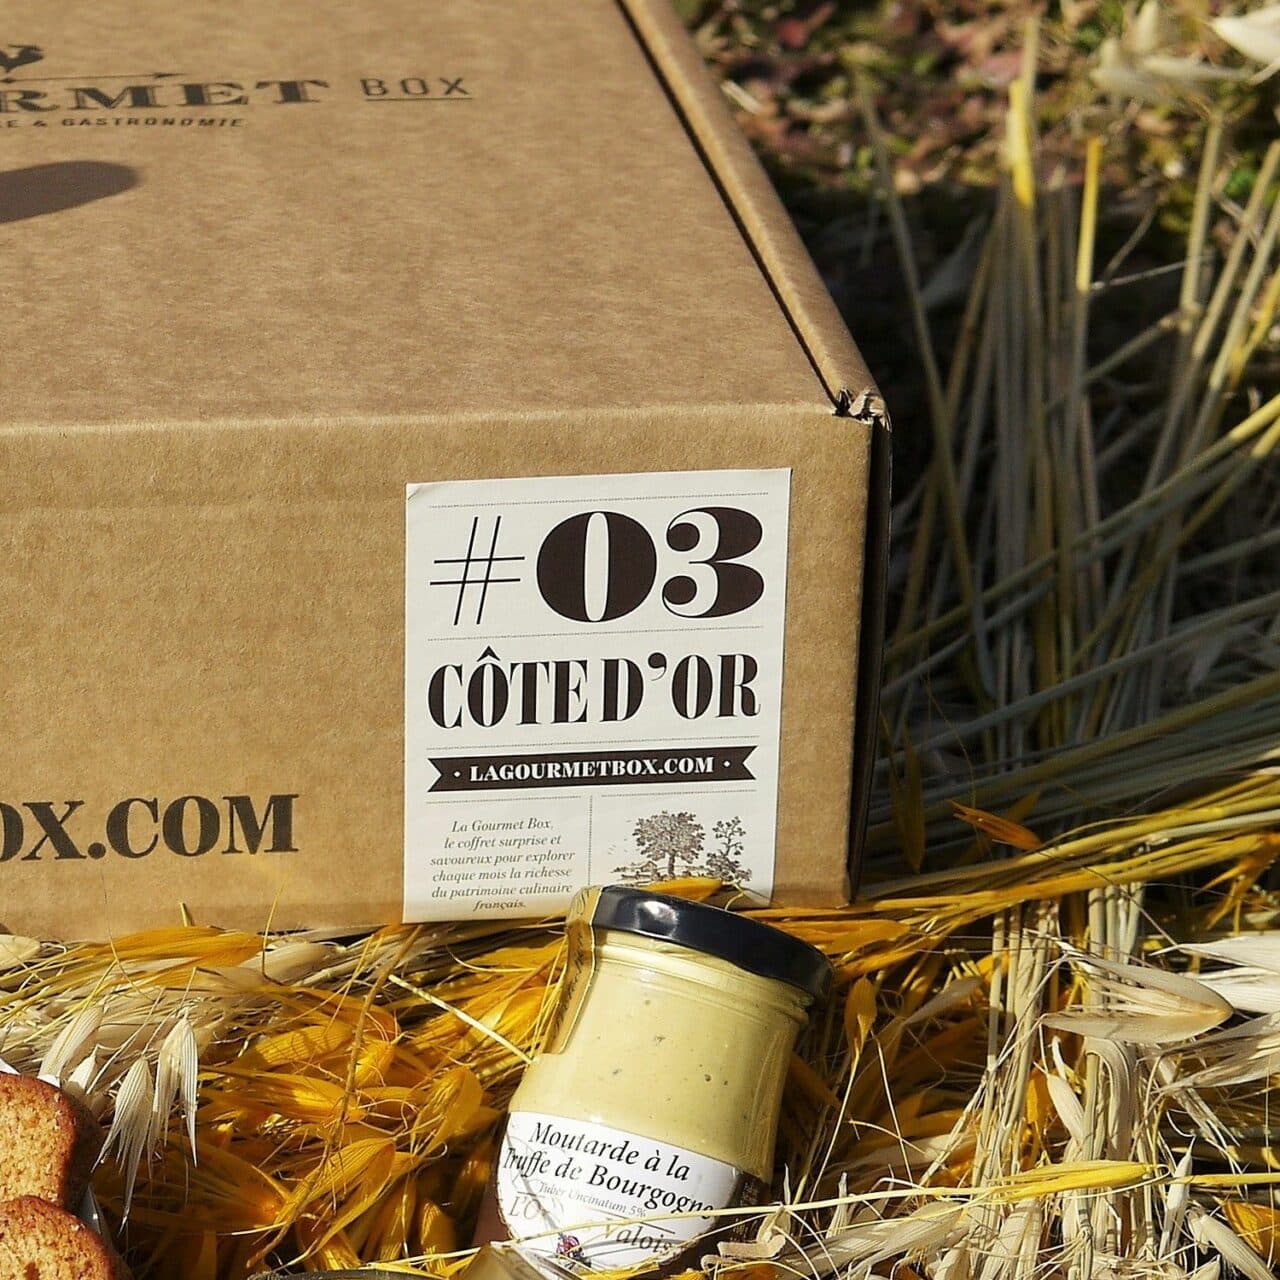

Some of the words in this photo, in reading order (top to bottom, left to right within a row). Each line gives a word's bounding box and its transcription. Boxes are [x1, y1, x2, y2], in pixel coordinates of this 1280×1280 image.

[359, 76, 470, 98] BOX
[32, 118, 48, 129] &
[60, 117, 245, 128] GASTRONOMIE
[429, 506, 766, 626] #03
[427, 646, 589, 730] CÔTE
[469, 756, 715, 783] LAGOURMETBOX.COM
[451, 820, 469, 833] La
[471, 819, 525, 832] Gourmet
[528, 817, 555, 831] Box,
[443, 837, 456, 849] le
[457, 836, 497, 852] coffret
[498, 835, 549, 850] surprise
[550, 835, 562, 846] et
[429, 855, 493, 867] savoureux
[493, 854, 524, 867] pour
[525, 849, 576, 865] explorer
[432, 869, 476, 884] chaque
[478, 868, 507, 881] mois
[509, 867, 522, 879] la
[524, 866, 572, 879] richesse
[431, 886, 448, 899] du
[448, 885, 517, 900] patrimoine
[519, 883, 573, 895] culinaire
[472, 899, 527, 912] français.
[528, 1121, 640, 1166] Moutarde
[644, 1149, 662, 1172] à
[666, 1154, 691, 1182] la
[503, 1147, 551, 1178] Truffe
[554, 1156, 584, 1181] de
[588, 1164, 714, 1220] Bourgogne
[628, 1204, 647, 1219] 5%
